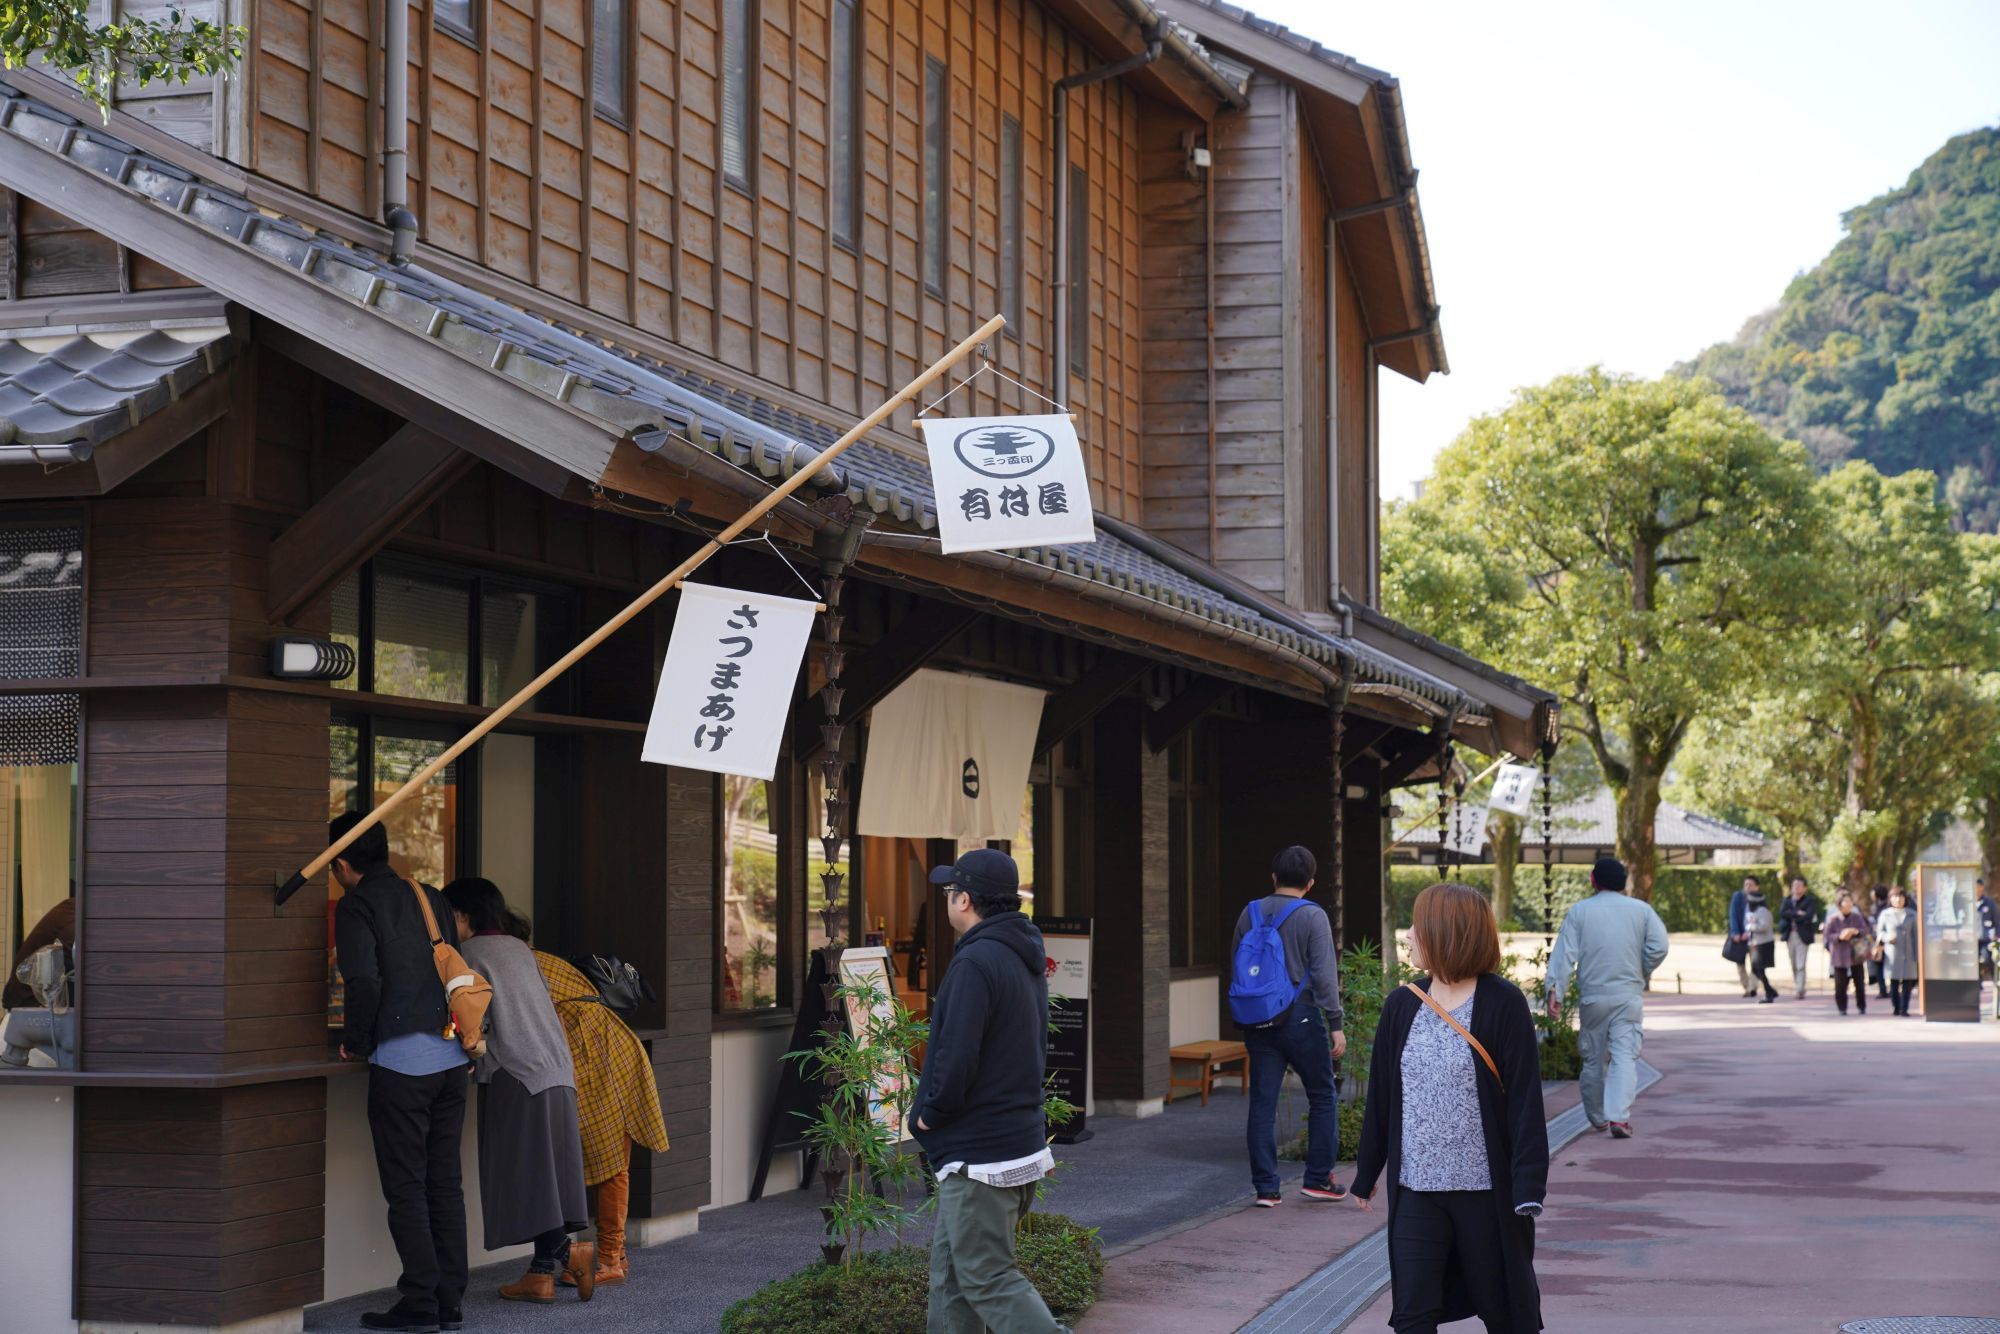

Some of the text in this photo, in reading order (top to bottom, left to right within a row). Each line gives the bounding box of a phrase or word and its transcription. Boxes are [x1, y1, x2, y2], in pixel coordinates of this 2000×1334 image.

[959, 482, 1069, 522] 有村屋
[694, 604, 760, 752] さつまあげ
